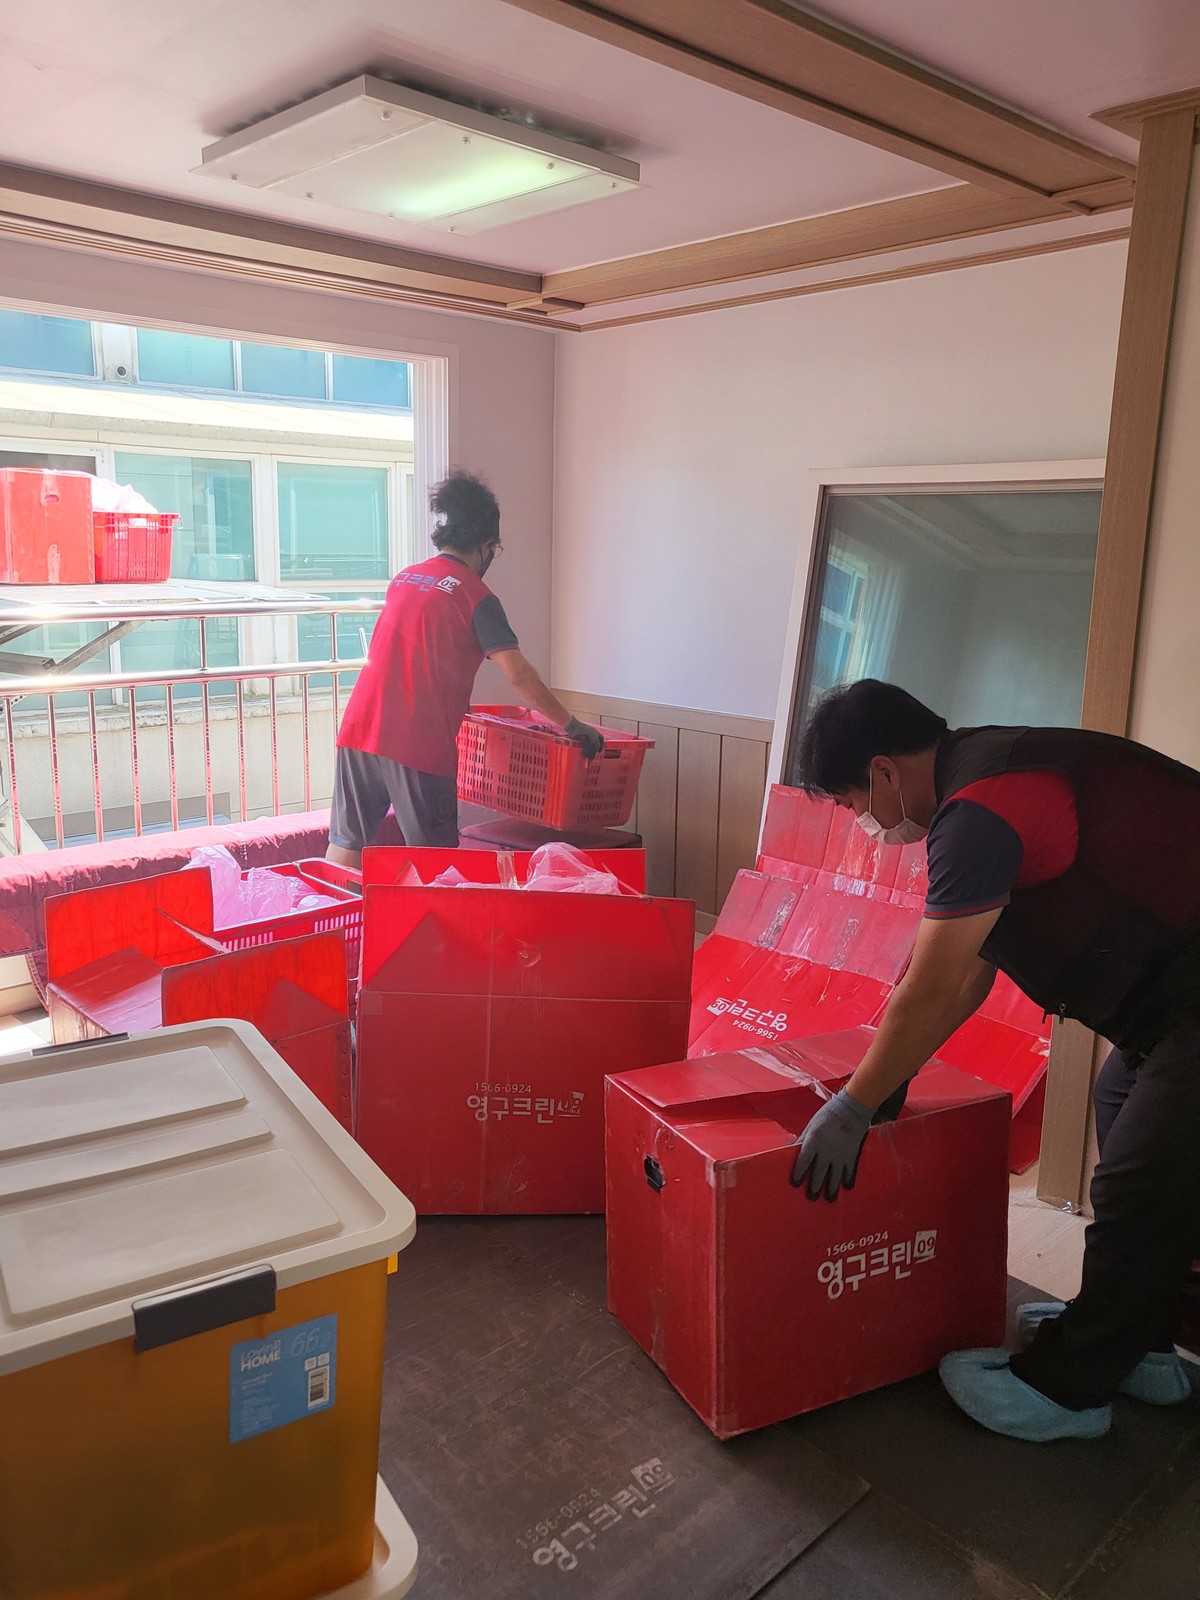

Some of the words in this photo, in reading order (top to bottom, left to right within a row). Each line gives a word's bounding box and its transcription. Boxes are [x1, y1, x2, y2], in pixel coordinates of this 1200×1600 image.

[732, 1018, 779, 1041] 1566-0924
[825, 1230, 889, 1258] 1566-0924
[240, 1349, 281, 1373] HOME
